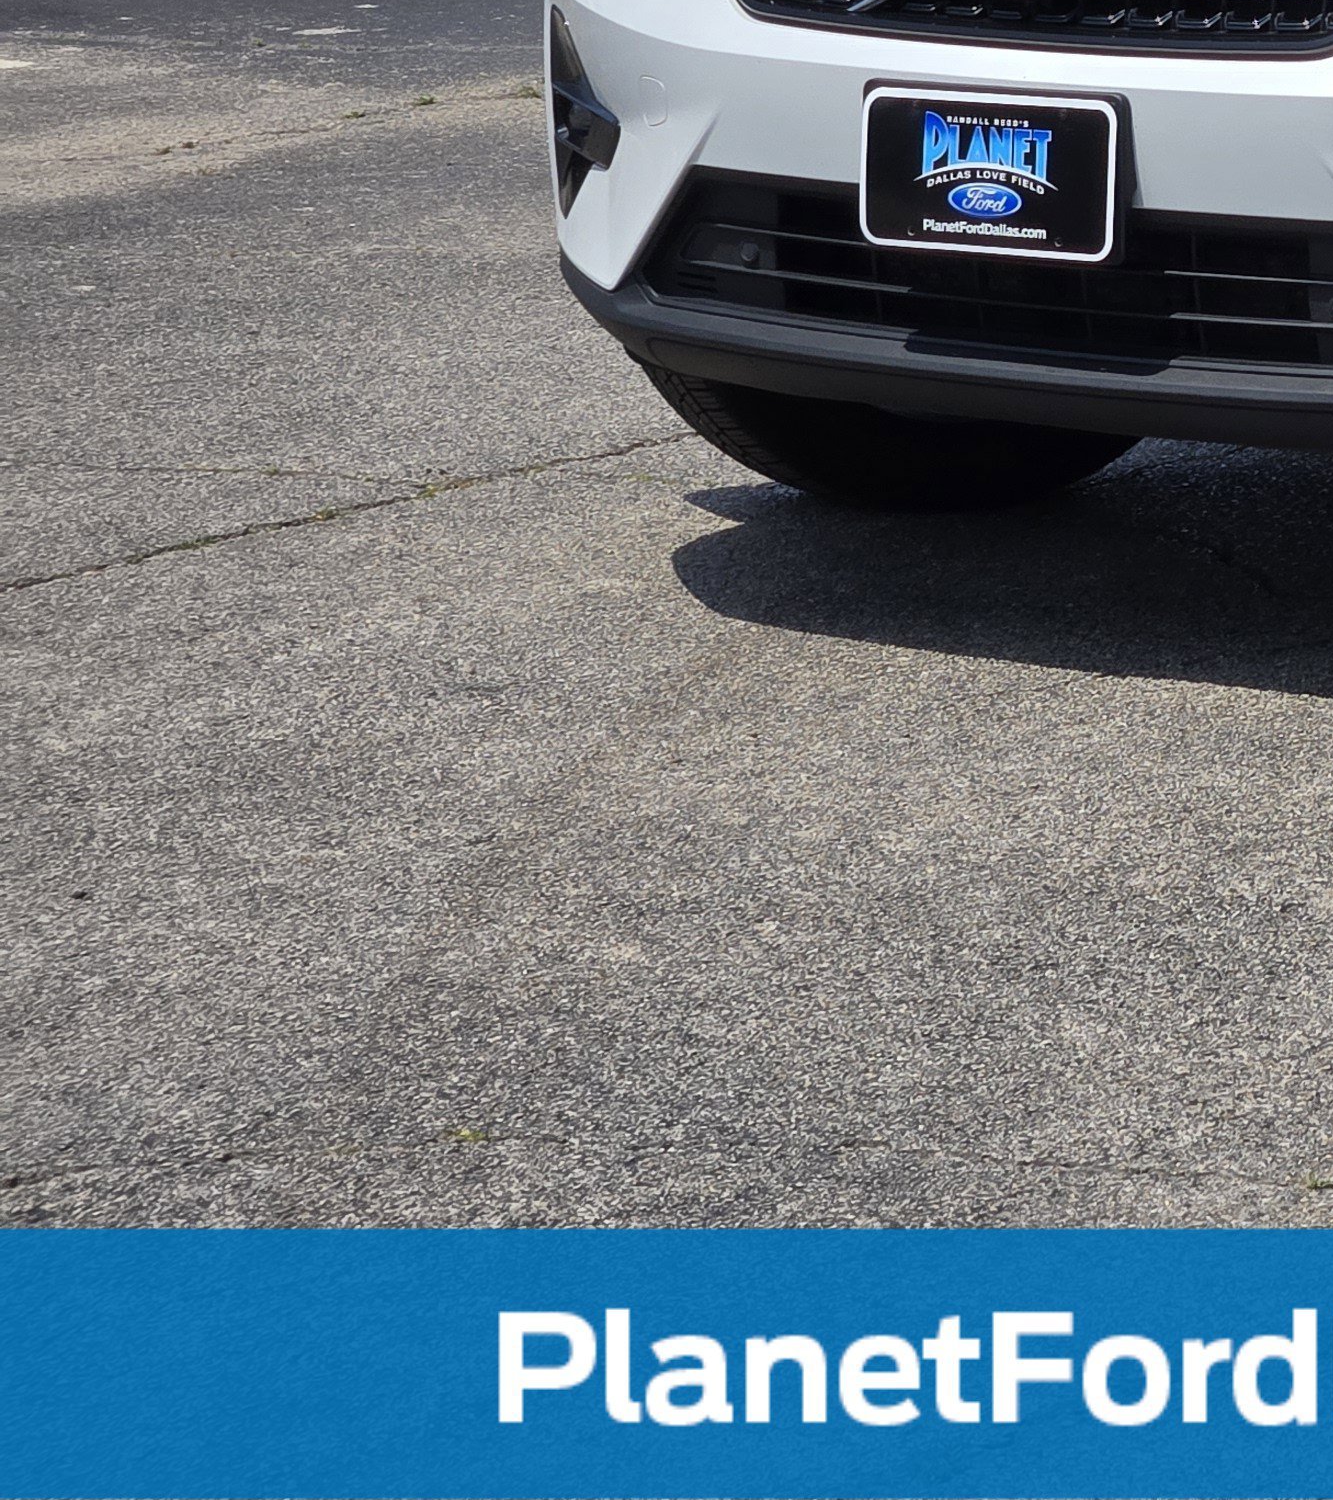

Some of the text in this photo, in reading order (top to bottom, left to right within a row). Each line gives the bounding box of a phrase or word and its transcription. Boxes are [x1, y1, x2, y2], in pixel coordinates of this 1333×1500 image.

[922, 110, 1053, 182] PLANET
[926, 169, 1046, 196] DALLAS LOVE FIELD
[961, 186, 1008, 213] Ford
[922, 218, 1047, 241] PlanetFordDallas.com
